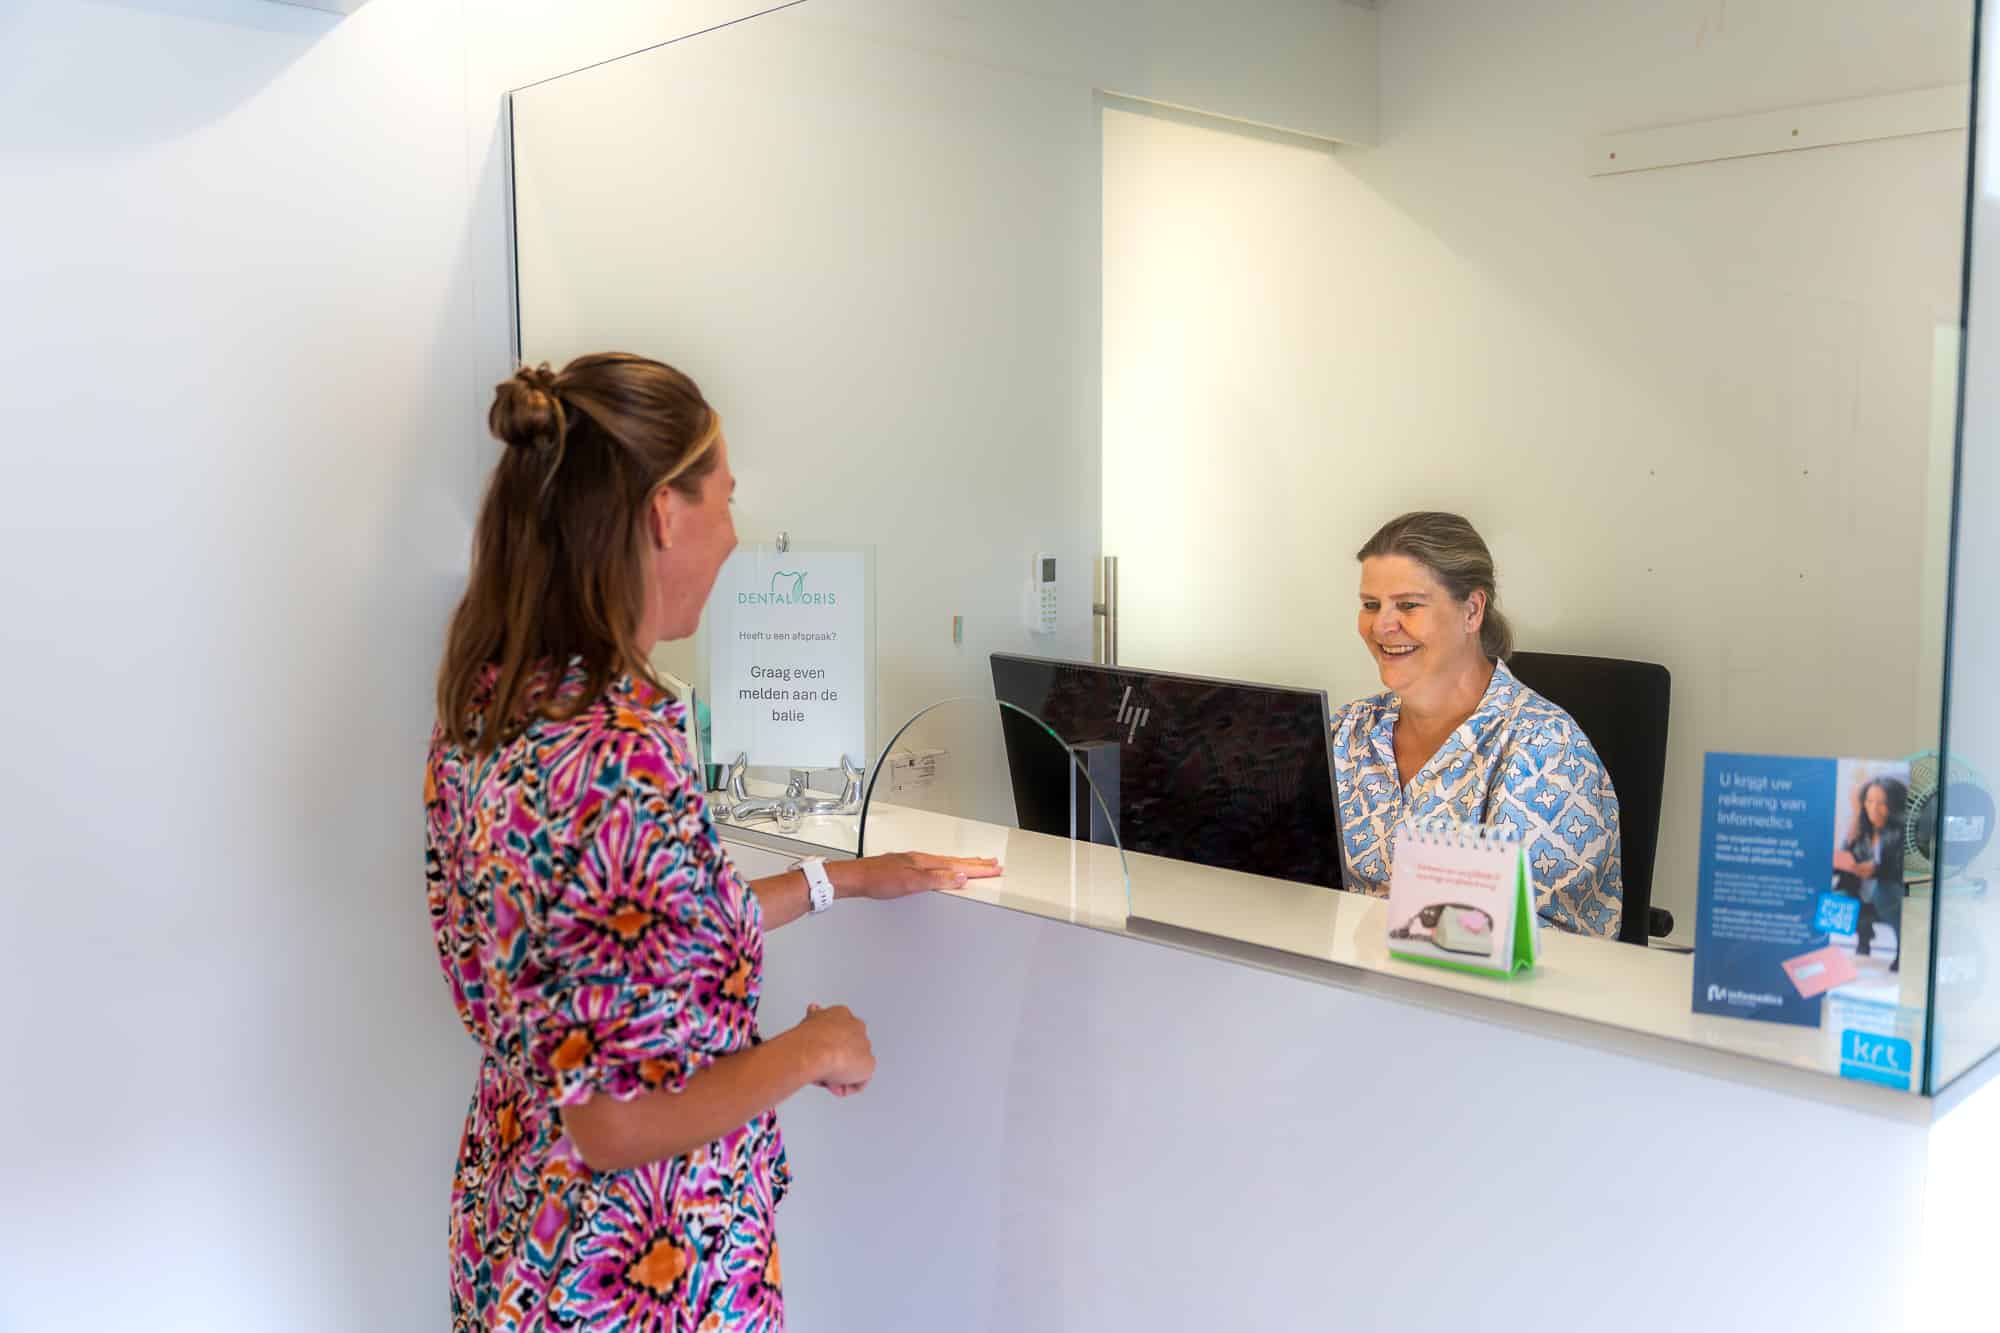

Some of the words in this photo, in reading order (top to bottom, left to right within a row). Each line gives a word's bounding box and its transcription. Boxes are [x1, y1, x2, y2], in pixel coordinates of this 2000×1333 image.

[738, 592, 793, 605] DENTAL
[801, 592, 836, 605] ORIS
[739, 631, 763, 641] Heeft
[773, 632, 790, 641] een
[792, 631, 838, 643] afspraak?
[750, 665, 791, 682] Graag
[793, 668, 825, 679] even
[739, 687, 789, 700] melden
[792, 690, 817, 701] aan
[820, 688, 838, 701] de
[772, 708, 806, 722] balie
[1719, 771, 1732, 788] U
[1718, 793, 1777, 814] rekening
[1780, 799, 1808, 812] van
